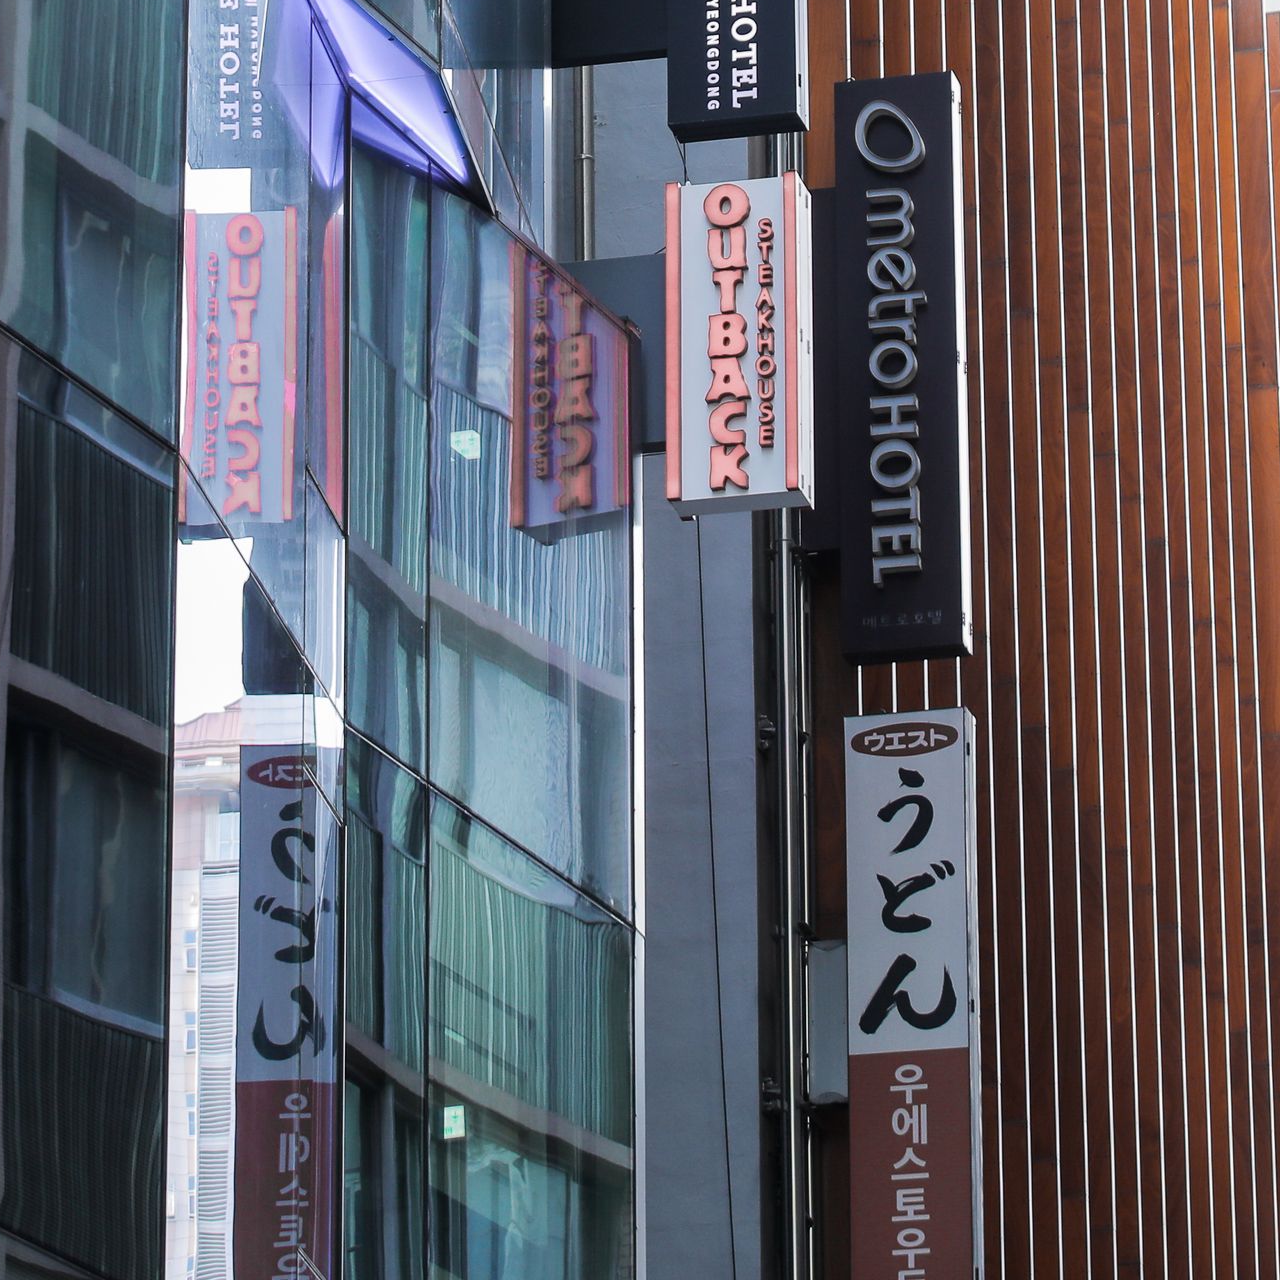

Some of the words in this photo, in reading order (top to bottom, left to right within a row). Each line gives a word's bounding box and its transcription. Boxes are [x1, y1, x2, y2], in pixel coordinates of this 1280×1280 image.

[703, 183, 752, 491] OUTBACK
[754, 218, 777, 448] STEAKHOUSE
[864, 728, 948, 752] ウエスト
[858, 766, 957, 1035] うどん
[889, 1063, 930, 1280] 우에스토우
